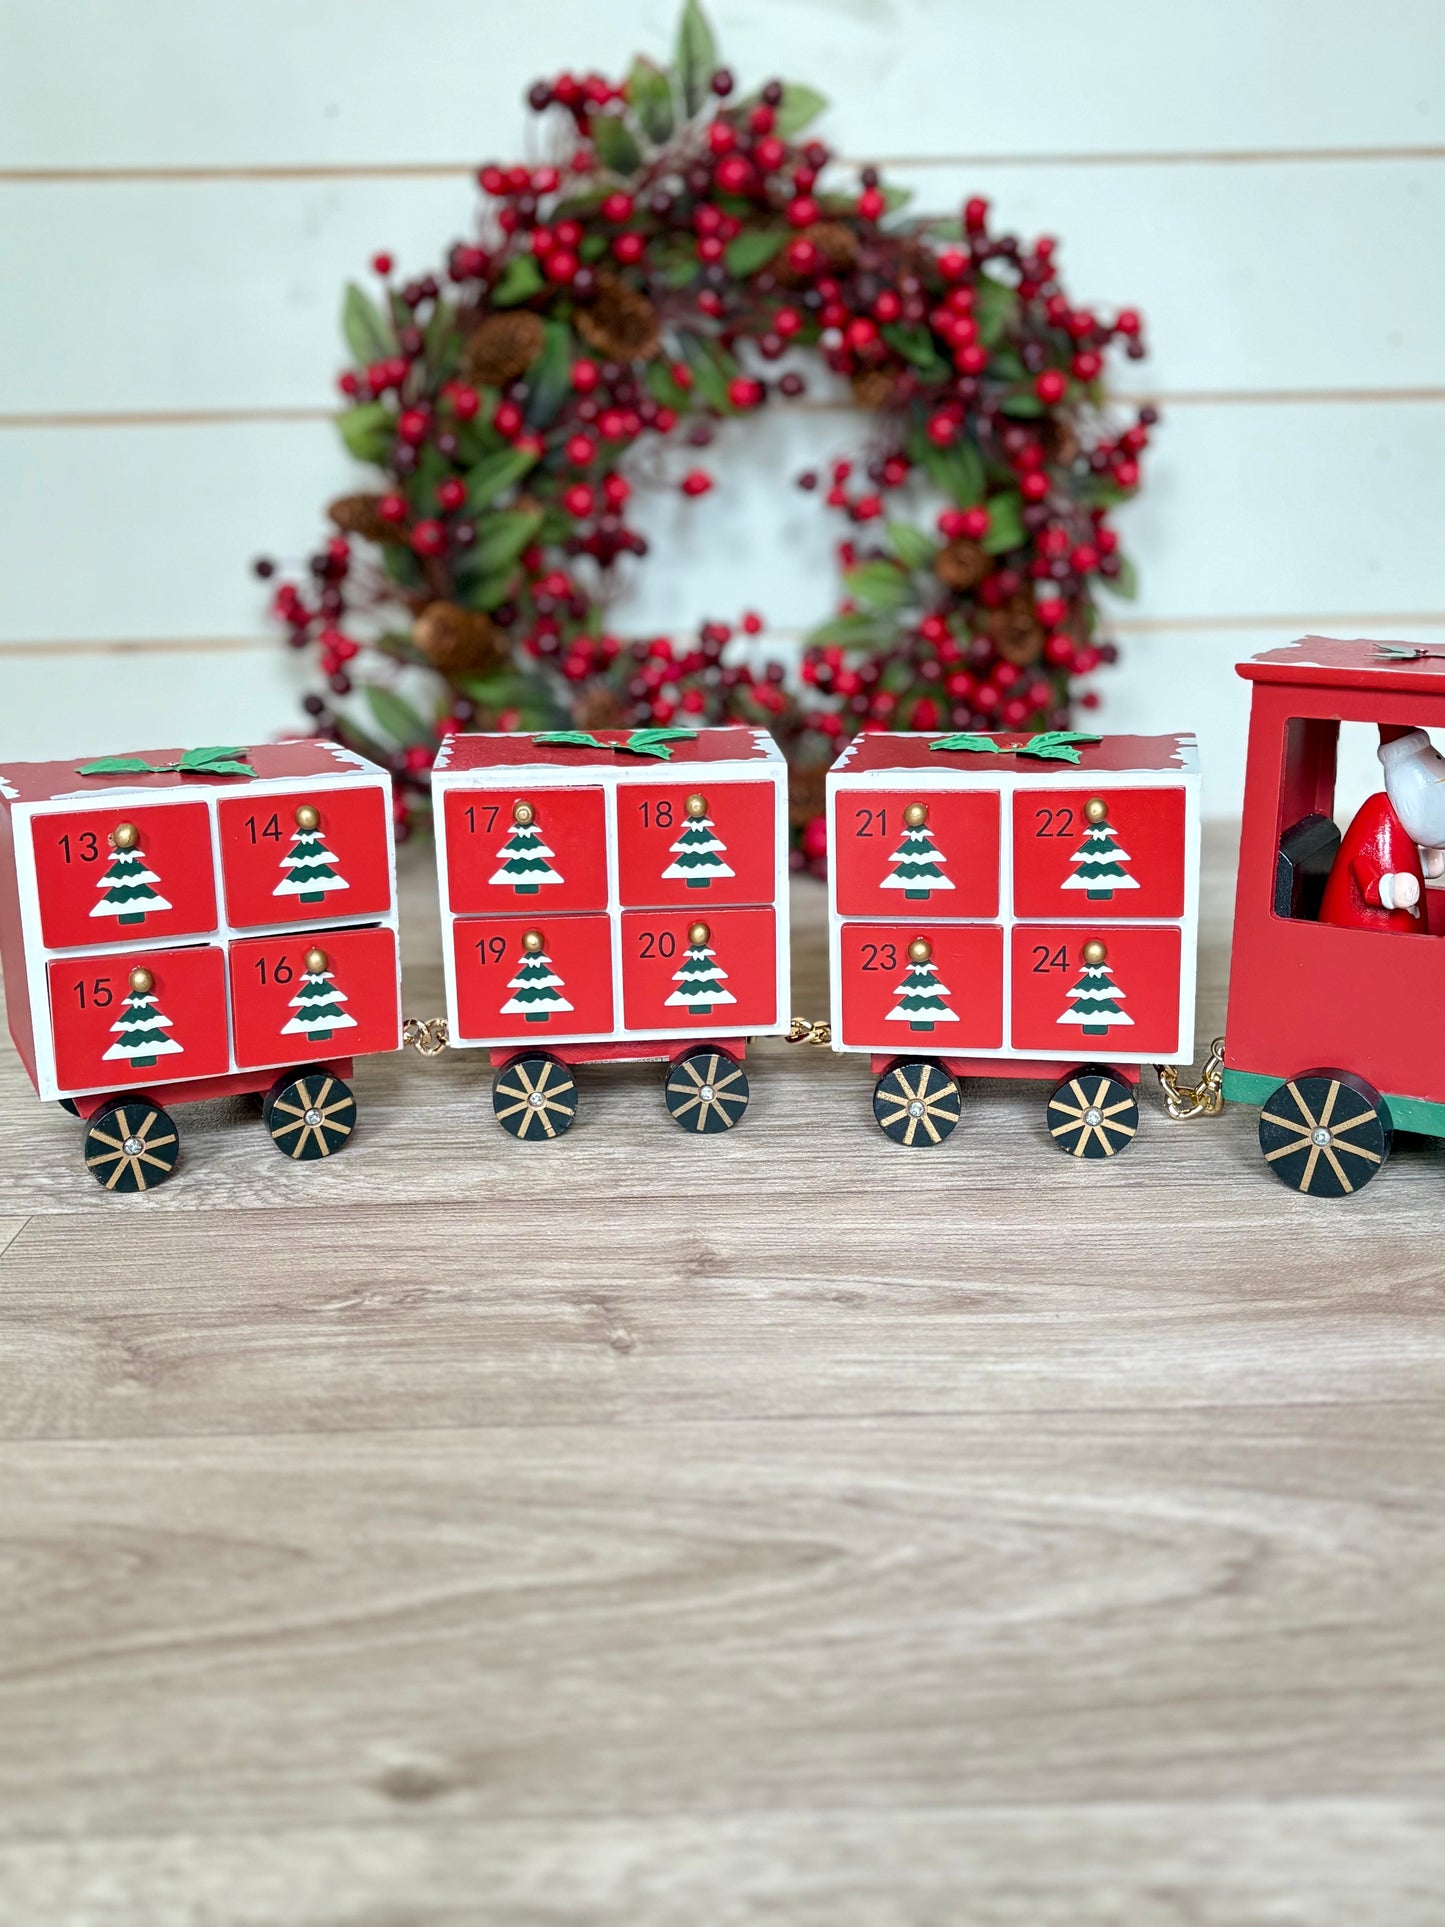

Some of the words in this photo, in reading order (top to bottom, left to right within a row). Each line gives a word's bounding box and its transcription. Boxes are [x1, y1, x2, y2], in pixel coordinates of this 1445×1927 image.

[465, 807, 498, 832] 17
[640, 802, 672, 827] 18
[856, 810, 885, 836] 21
[1036, 809, 1073, 836] 22
[246, 814, 282, 844] 14
[59, 833, 98, 863] 13
[476, 937, 505, 964] 19
[639, 932, 675, 958] 20
[862, 944, 896, 970] 23
[256, 957, 292, 984] 16
[1033, 946, 1069, 972] 24
[74, 979, 112, 1008] 15
